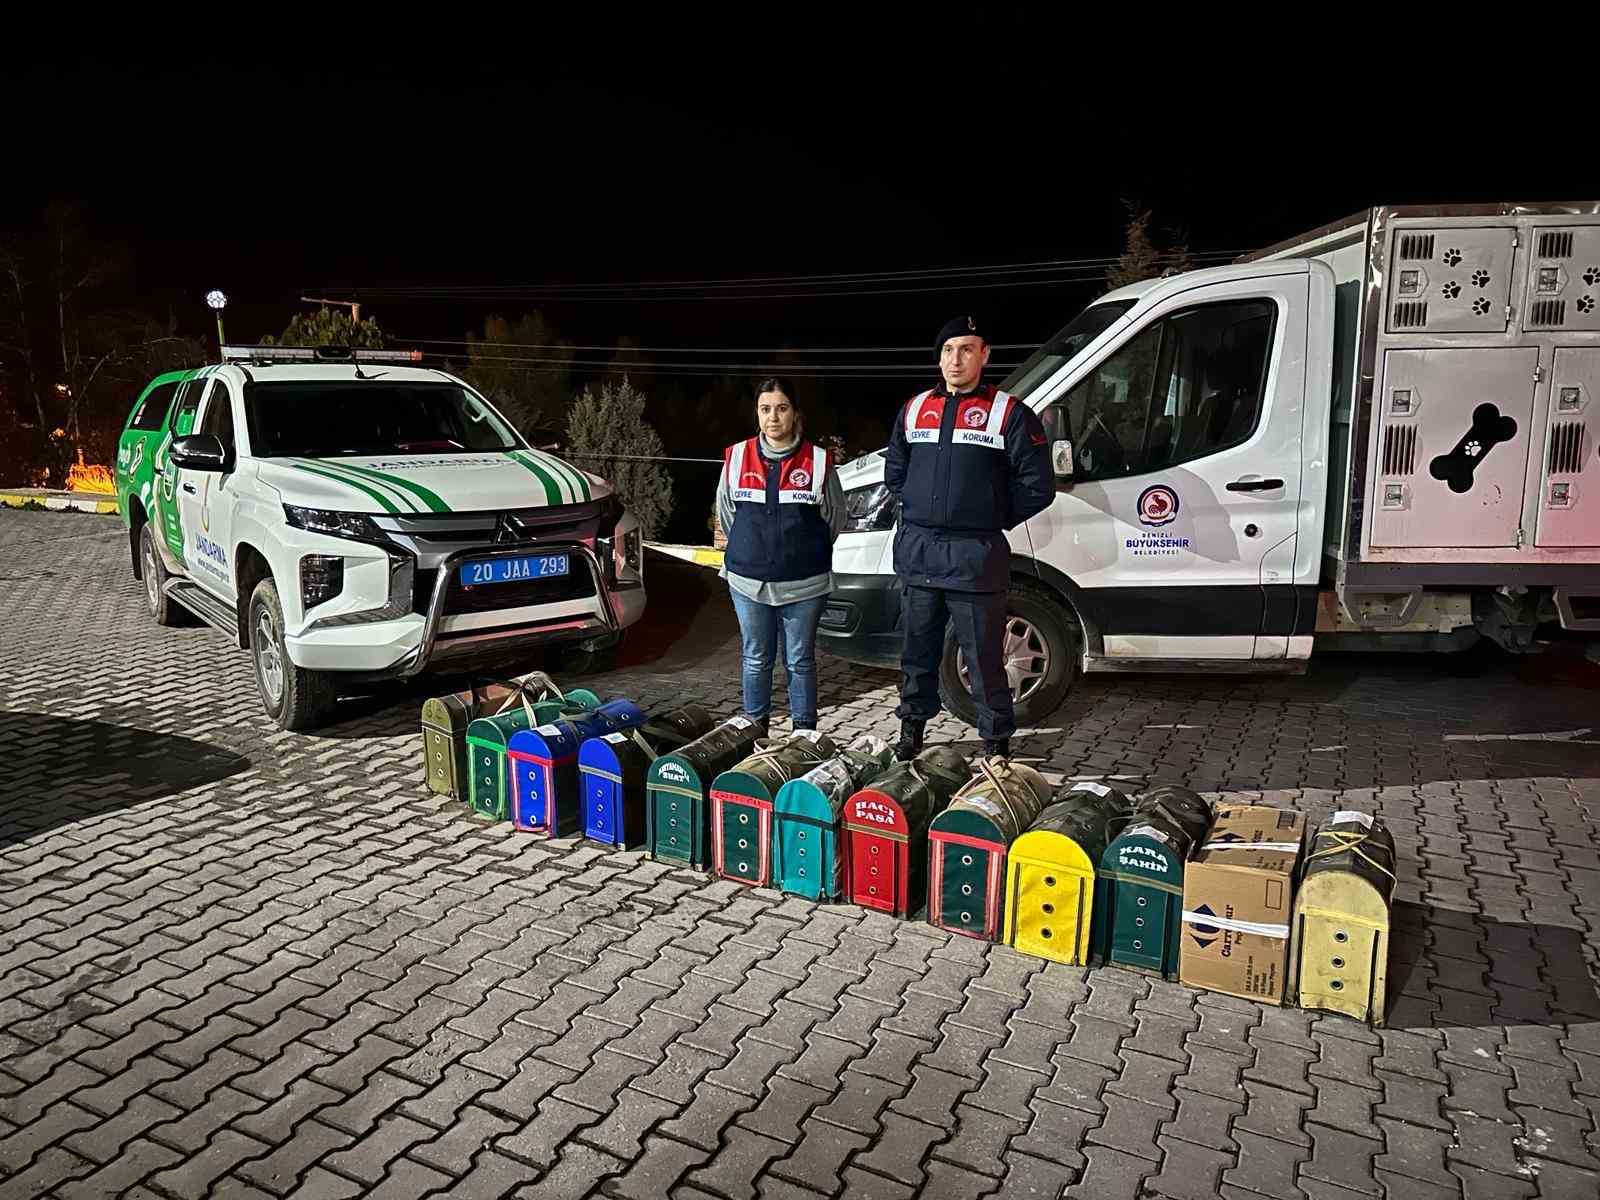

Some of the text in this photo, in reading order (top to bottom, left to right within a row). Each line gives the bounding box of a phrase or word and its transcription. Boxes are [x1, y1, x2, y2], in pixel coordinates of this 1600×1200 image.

[963, 432, 994, 444] KORUMA
[473, 556, 566, 582] 20 JAA 293
[855, 801, 895, 818] HACI
[1119, 846, 1169, 866] KARA
